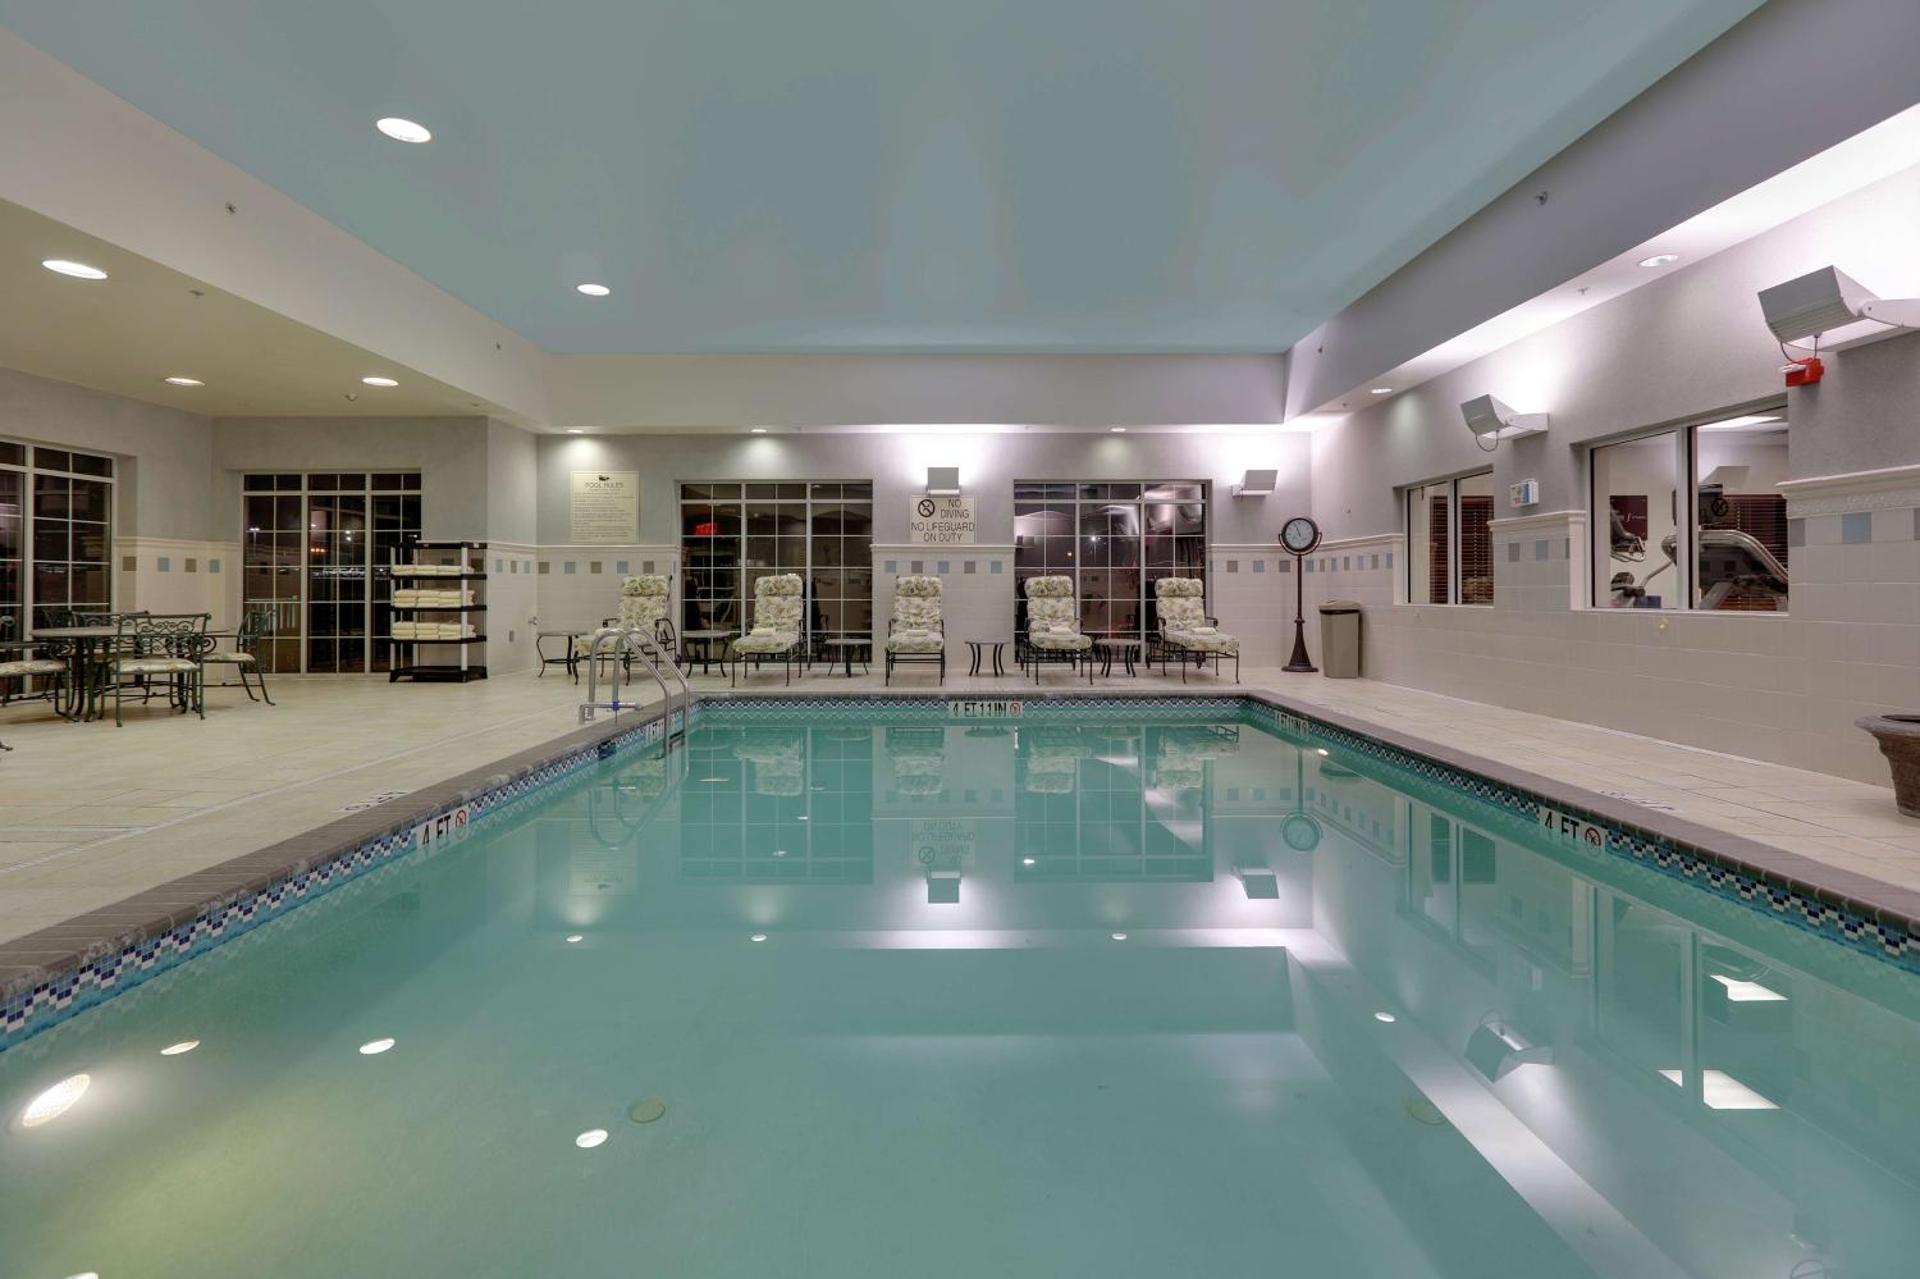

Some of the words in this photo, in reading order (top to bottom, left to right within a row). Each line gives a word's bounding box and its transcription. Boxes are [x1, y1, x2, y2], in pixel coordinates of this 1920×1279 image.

[948, 499, 961, 508] NO
[941, 509, 969, 519] DIVING
[911, 522, 924, 531] NO
[926, 522, 975, 531] LIFEGUARD
[924, 532, 937, 542] ON
[939, 532, 963, 542] DUTY
[437, 814, 451, 839] FT
[1562, 816, 1580, 839] FT
